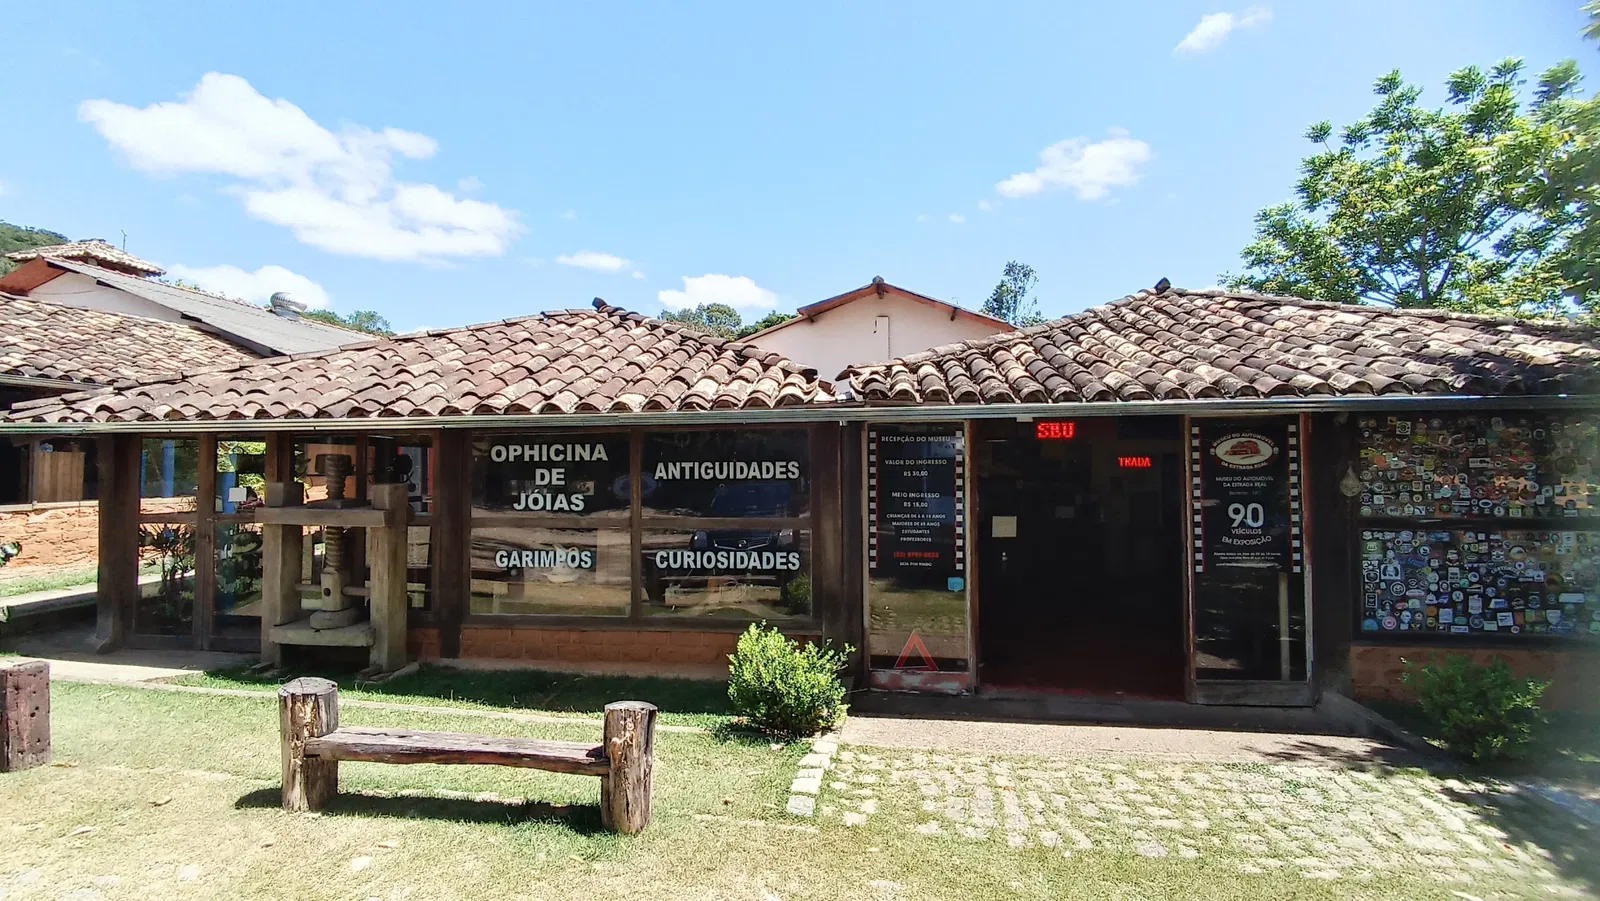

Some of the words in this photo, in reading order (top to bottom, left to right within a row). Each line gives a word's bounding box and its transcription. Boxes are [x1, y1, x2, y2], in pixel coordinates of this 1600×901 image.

[881, 435, 914, 443] RECEPÇÃO
[490, 444, 609, 463] OPHICINA
[1118, 457, 1151, 467] TRADA
[535, 468, 566, 486] DE
[654, 461, 800, 480] ANTIGUIDADES
[513, 489, 585, 512] JÓIAS
[1228, 503, 1264, 527] 90
[1221, 536, 1232, 544] EM
[1233, 535, 1272, 546] EXPOSIÇÃO
[495, 551, 592, 568] GARIMPOS
[655, 551, 800, 570] CURIOSIDADES
